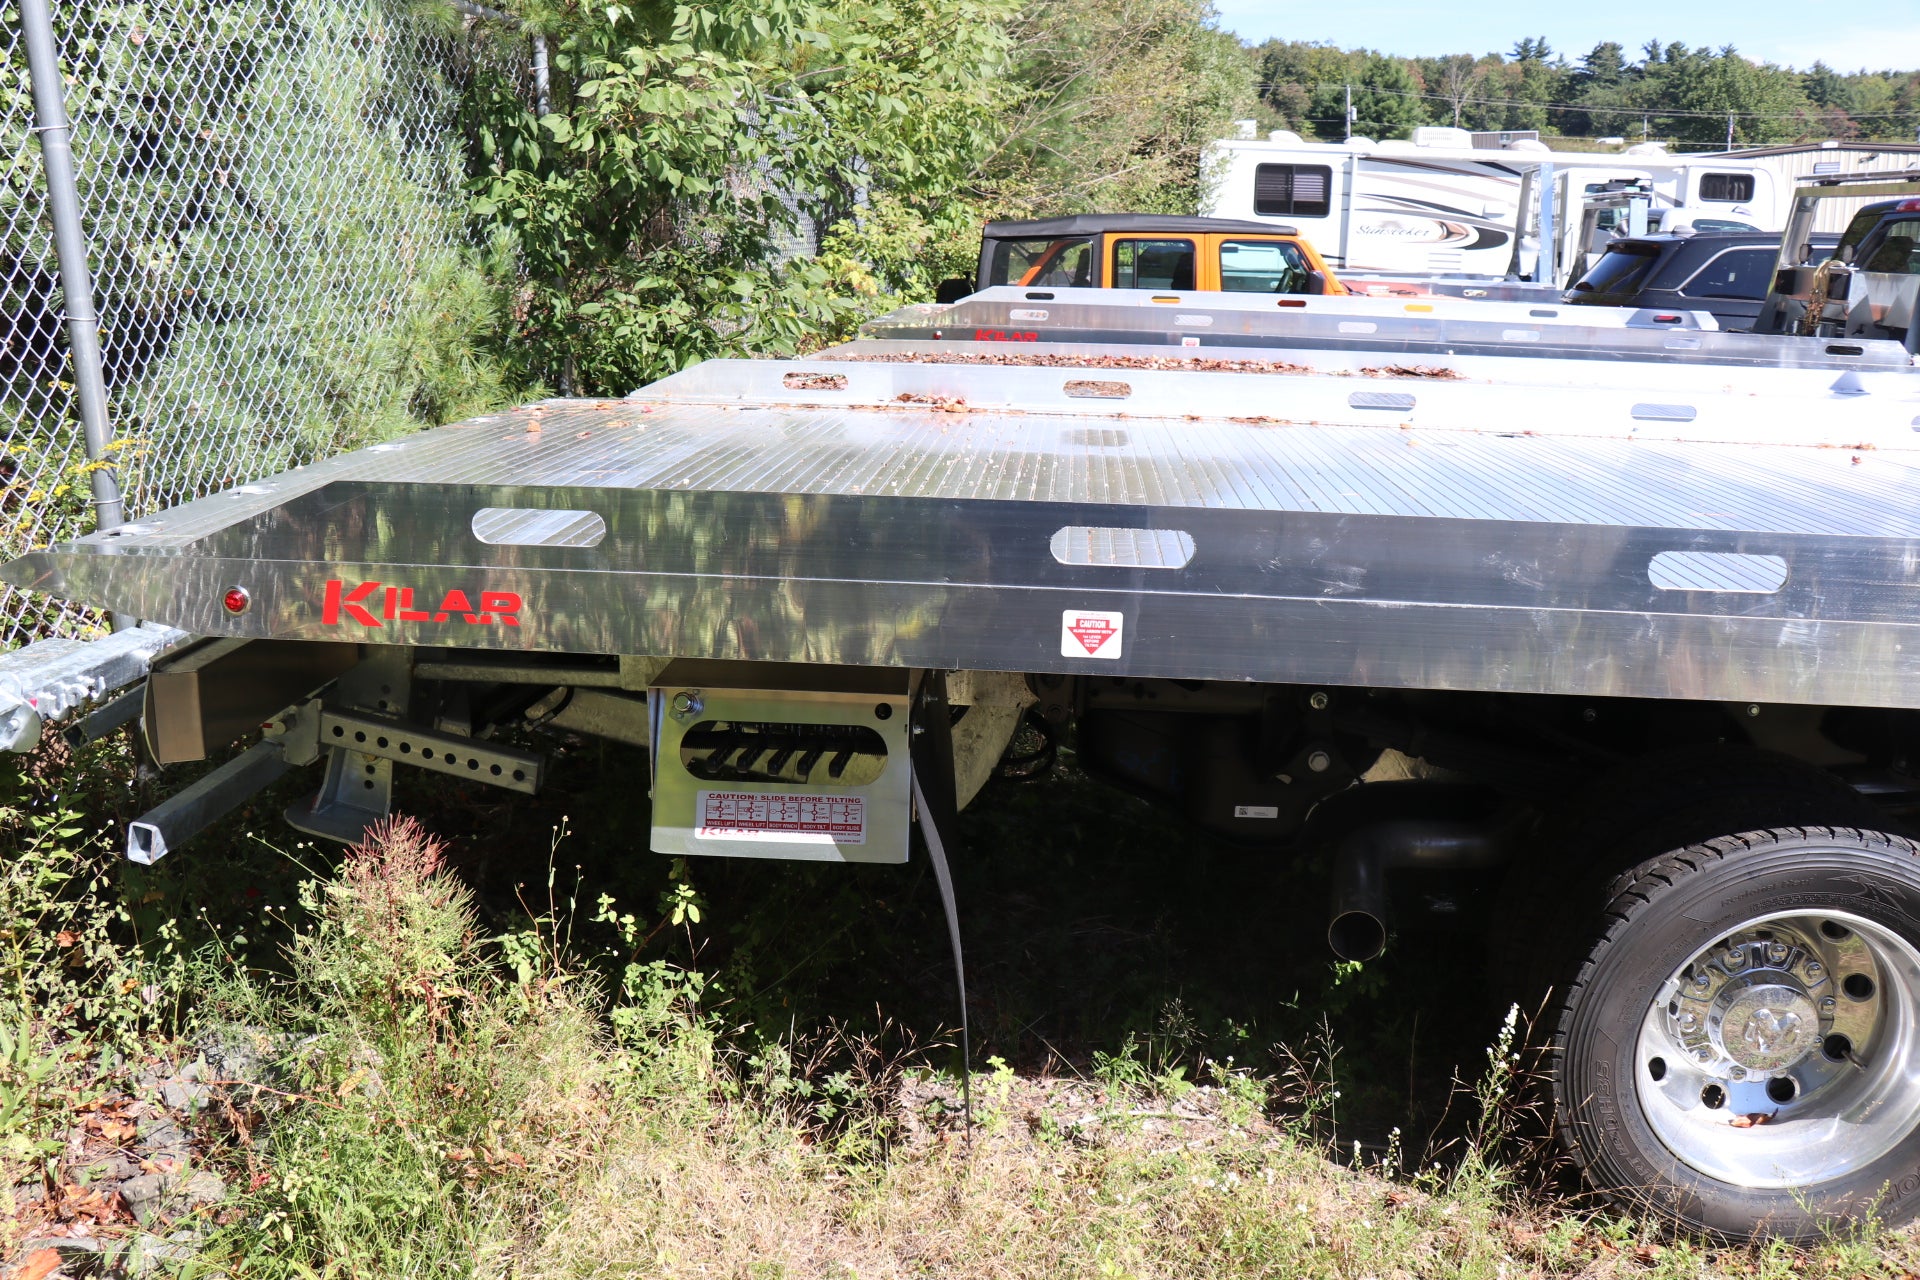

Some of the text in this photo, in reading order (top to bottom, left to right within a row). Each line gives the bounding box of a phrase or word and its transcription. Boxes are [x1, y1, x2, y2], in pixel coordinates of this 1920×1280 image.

[1356, 225, 1430, 237] Sunseeker
[322, 579, 522, 627] KILAR
[1080, 620, 1106, 628] CAUTION
[709, 793, 758, 801] CAUTION:
